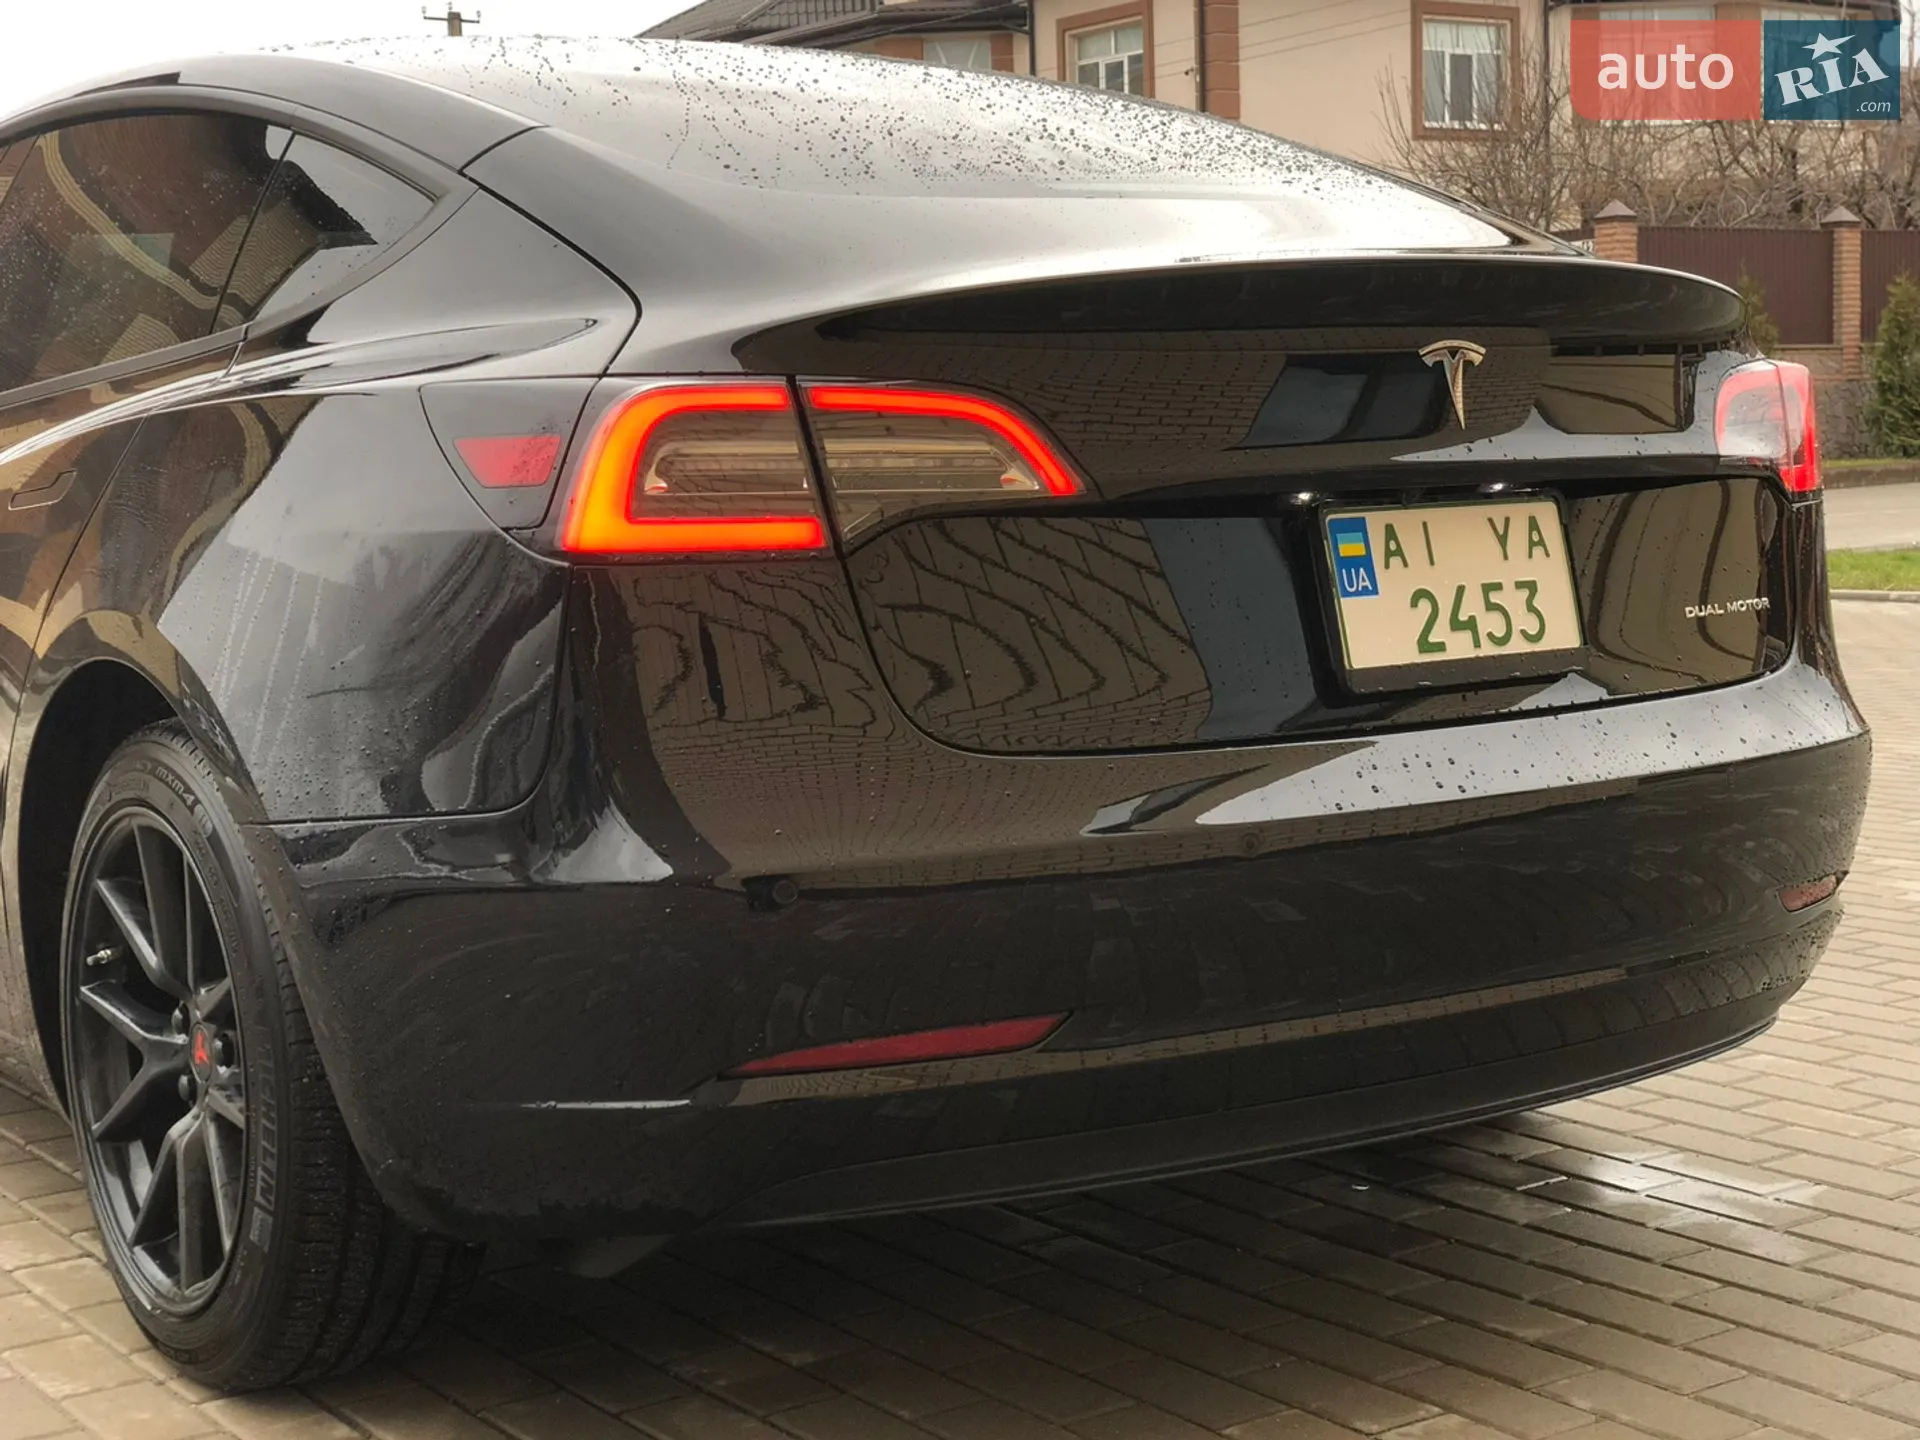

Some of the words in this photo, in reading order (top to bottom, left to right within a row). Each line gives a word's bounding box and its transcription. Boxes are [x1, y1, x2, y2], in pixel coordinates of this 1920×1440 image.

[1487, 515, 1550, 560] YA
[1342, 568, 1372, 592] UA
[1410, 580, 1546, 654] 2453
[1685, 604, 1724, 618] DUAL
[1726, 597, 1770, 612] MOTOR
